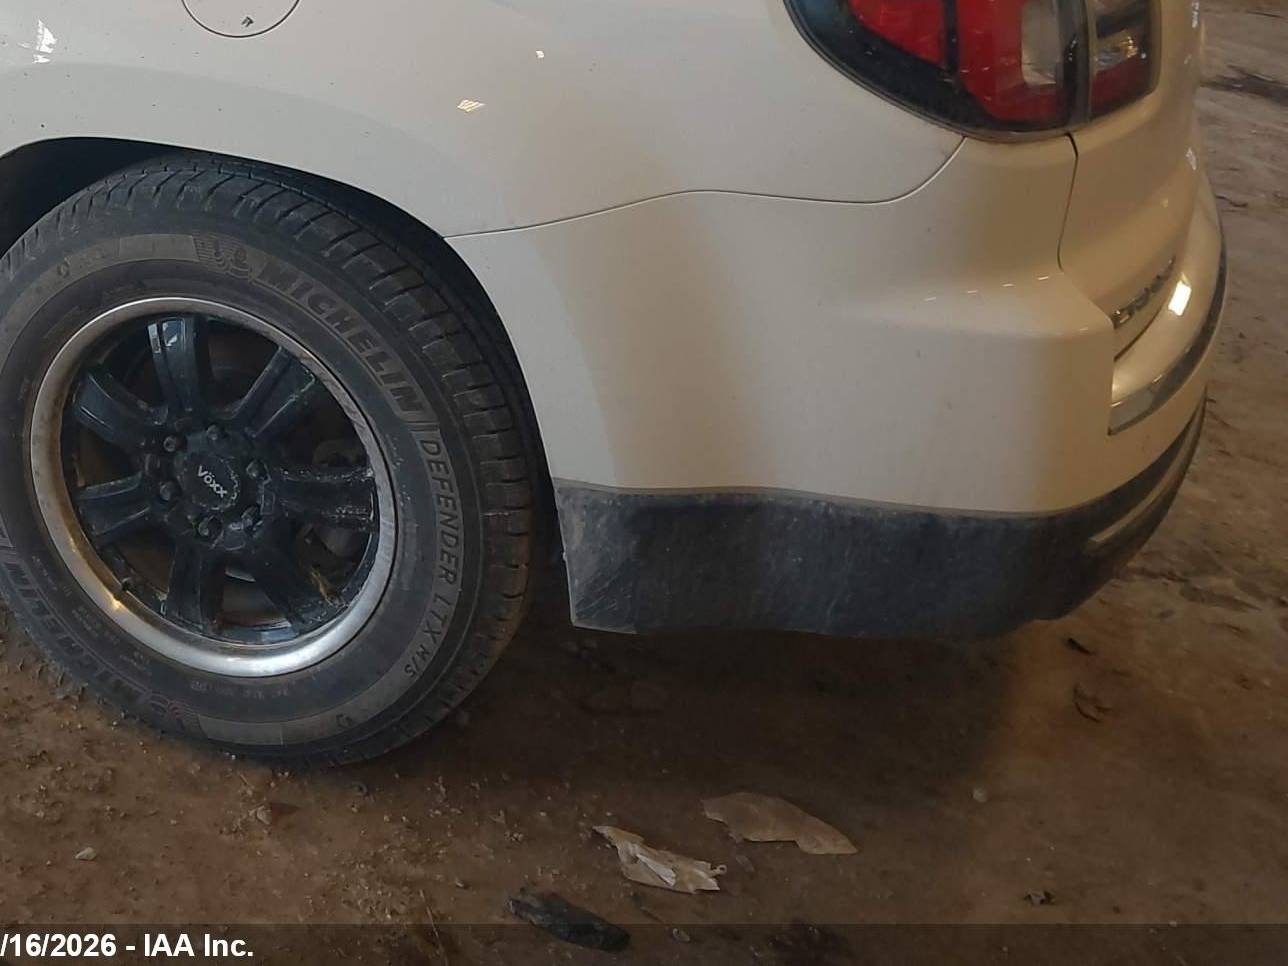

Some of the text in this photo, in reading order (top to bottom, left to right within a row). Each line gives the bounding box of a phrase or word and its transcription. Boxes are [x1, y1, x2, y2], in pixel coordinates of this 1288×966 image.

[255, 258, 428, 419] MICHELIN
[419, 439, 460, 585] DEFENDER
[421, 592, 454, 645] LTX
